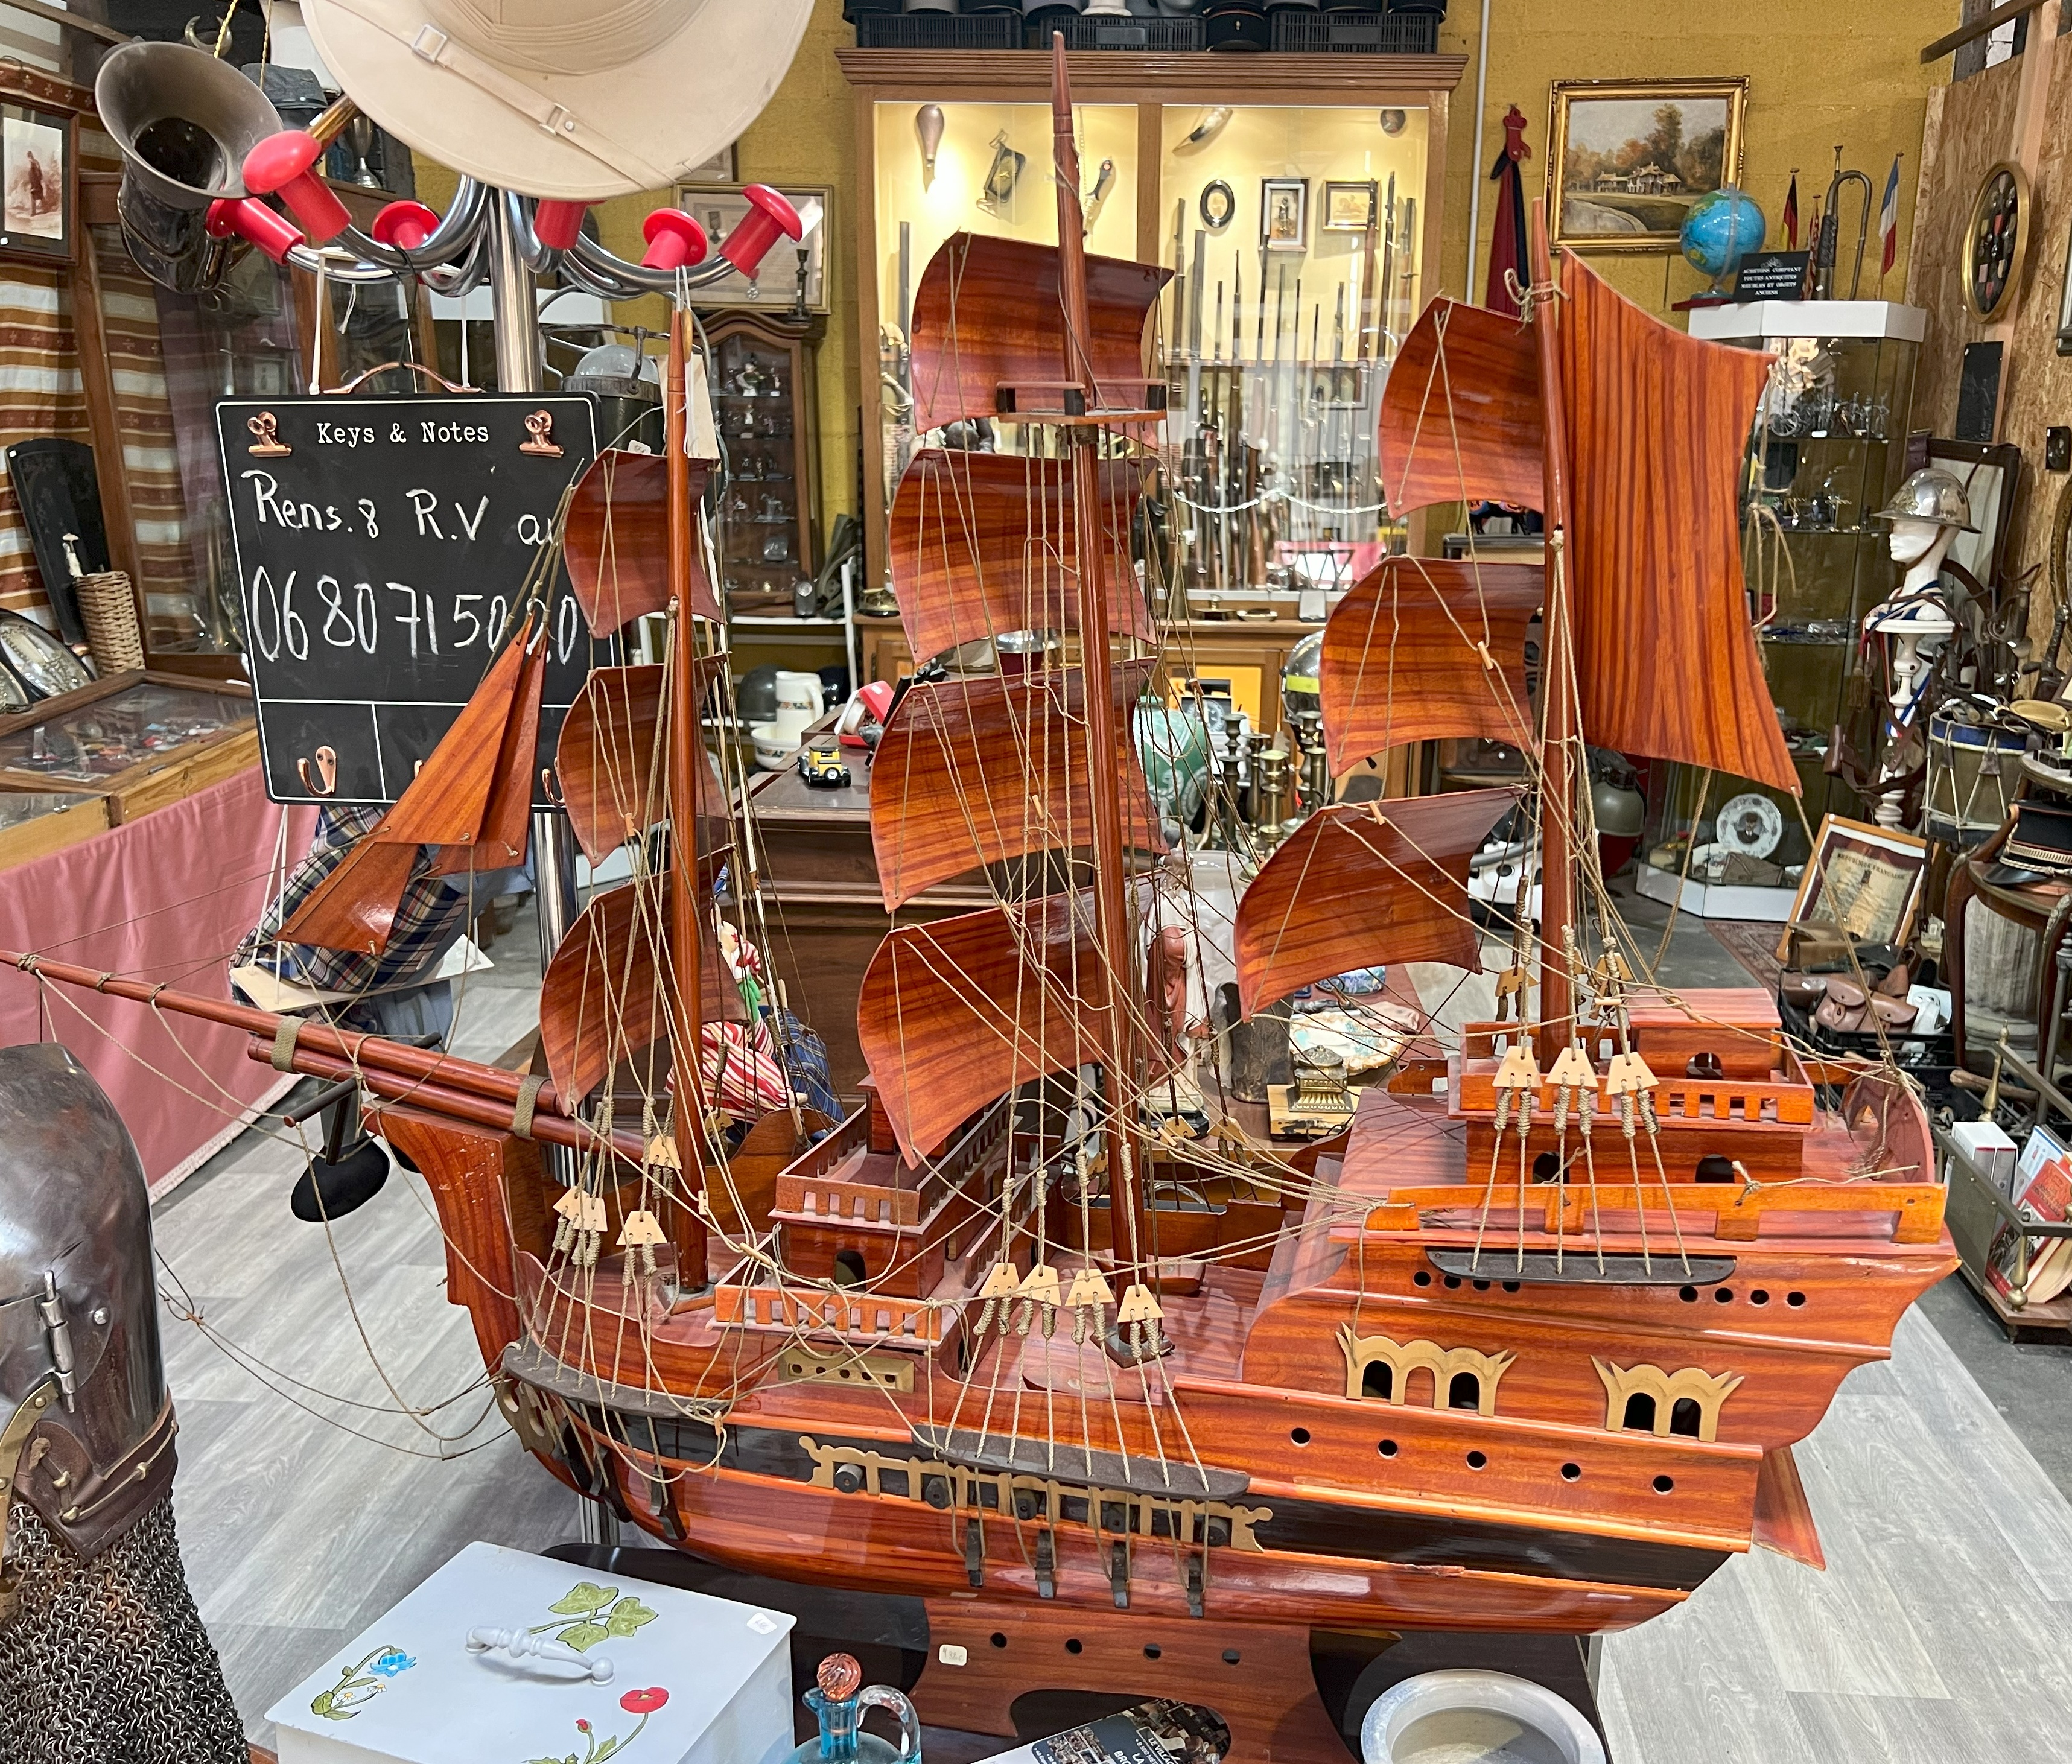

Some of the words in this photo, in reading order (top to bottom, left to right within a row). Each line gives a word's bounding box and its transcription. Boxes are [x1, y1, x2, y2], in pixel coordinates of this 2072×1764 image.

[316, 422, 375, 448] Keys
[390, 422, 407, 443] &
[421, 422, 489, 443] Notes
[1148, 1737, 1158, 1747] LE
